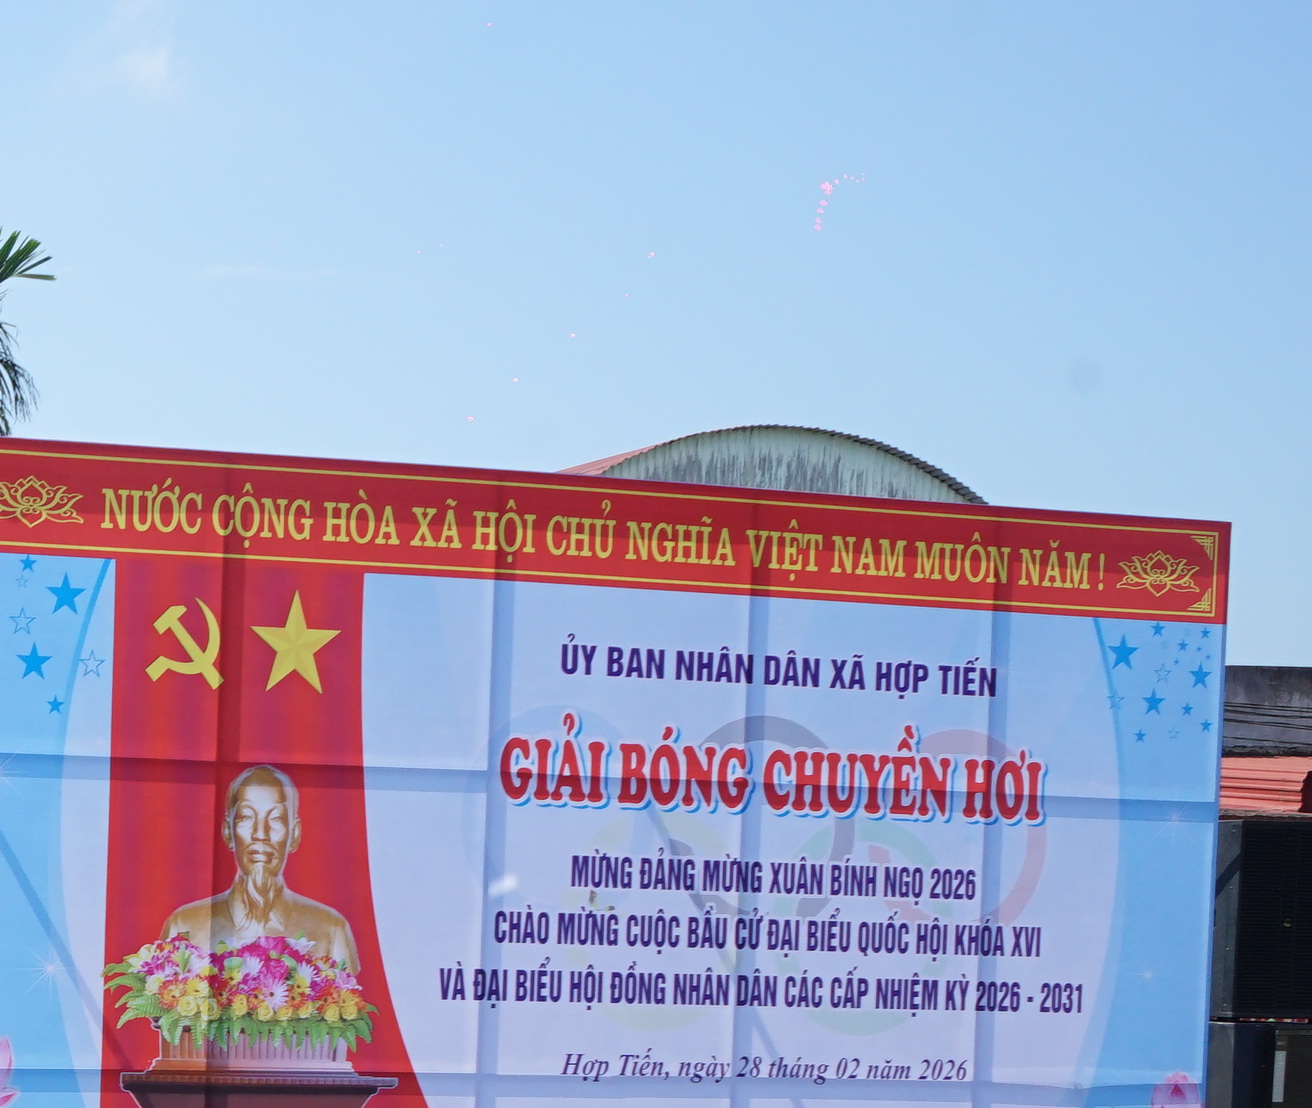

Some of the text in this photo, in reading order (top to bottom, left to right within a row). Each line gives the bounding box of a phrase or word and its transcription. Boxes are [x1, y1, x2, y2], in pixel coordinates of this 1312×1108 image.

[101, 478, 202, 531] NƯỚC
[212, 483, 313, 548] CỘNG
[323, 489, 400, 545] HÒA
[410, 499, 462, 548] XÃ
[472, 499, 536, 562] HỘI
[546, 500, 616, 558] CHỦ
[625, 517, 735, 566] NGHĨA
[746, 519, 822, 581] VIỆT
[831, 536, 906, 577] NAM
[914, 532, 1010, 583] MUÔN
[562, 634, 997, 699] ỦY BAN NHÂN DÂN XÃ HỢP TIẾN
[502, 714, 1041, 820] GIẢI BÓNG CHUYỀN HƠI
[571, 848, 975, 905] MỪNG ĐẢNG MỪNG XUÂN BÍNH NGỌ 2026
[494, 905, 1041, 961] CHÀO MỪNG CUỘC BẦU CỬ ĐẠI BIỂU QUỐC HỘI KHÓA XVI
[440, 961, 465, 1000] VÀ
[473, 969, 507, 1008] ĐẠI
[515, 957, 562, 1002] BIỂU
[570, 965, 603, 1010] HỘI
[610, 961, 666, 1004] ĐỒNG
[674, 967, 730, 1005] NHÂN
[736, 969, 777, 1006] DÂN
[785, 970, 823, 1008] CÁC
[831, 967, 868, 1008] CẤP
[876, 973, 938, 1017] NHIỆM
[945, 974, 969, 1010] KỲ
[975, 981, 1020, 1012] 2026
[1040, 983, 1082, 1013] 2031
[562, 1048, 966, 1085] Hợp Tiến, ngày 28 tháng 02 năm 2026
